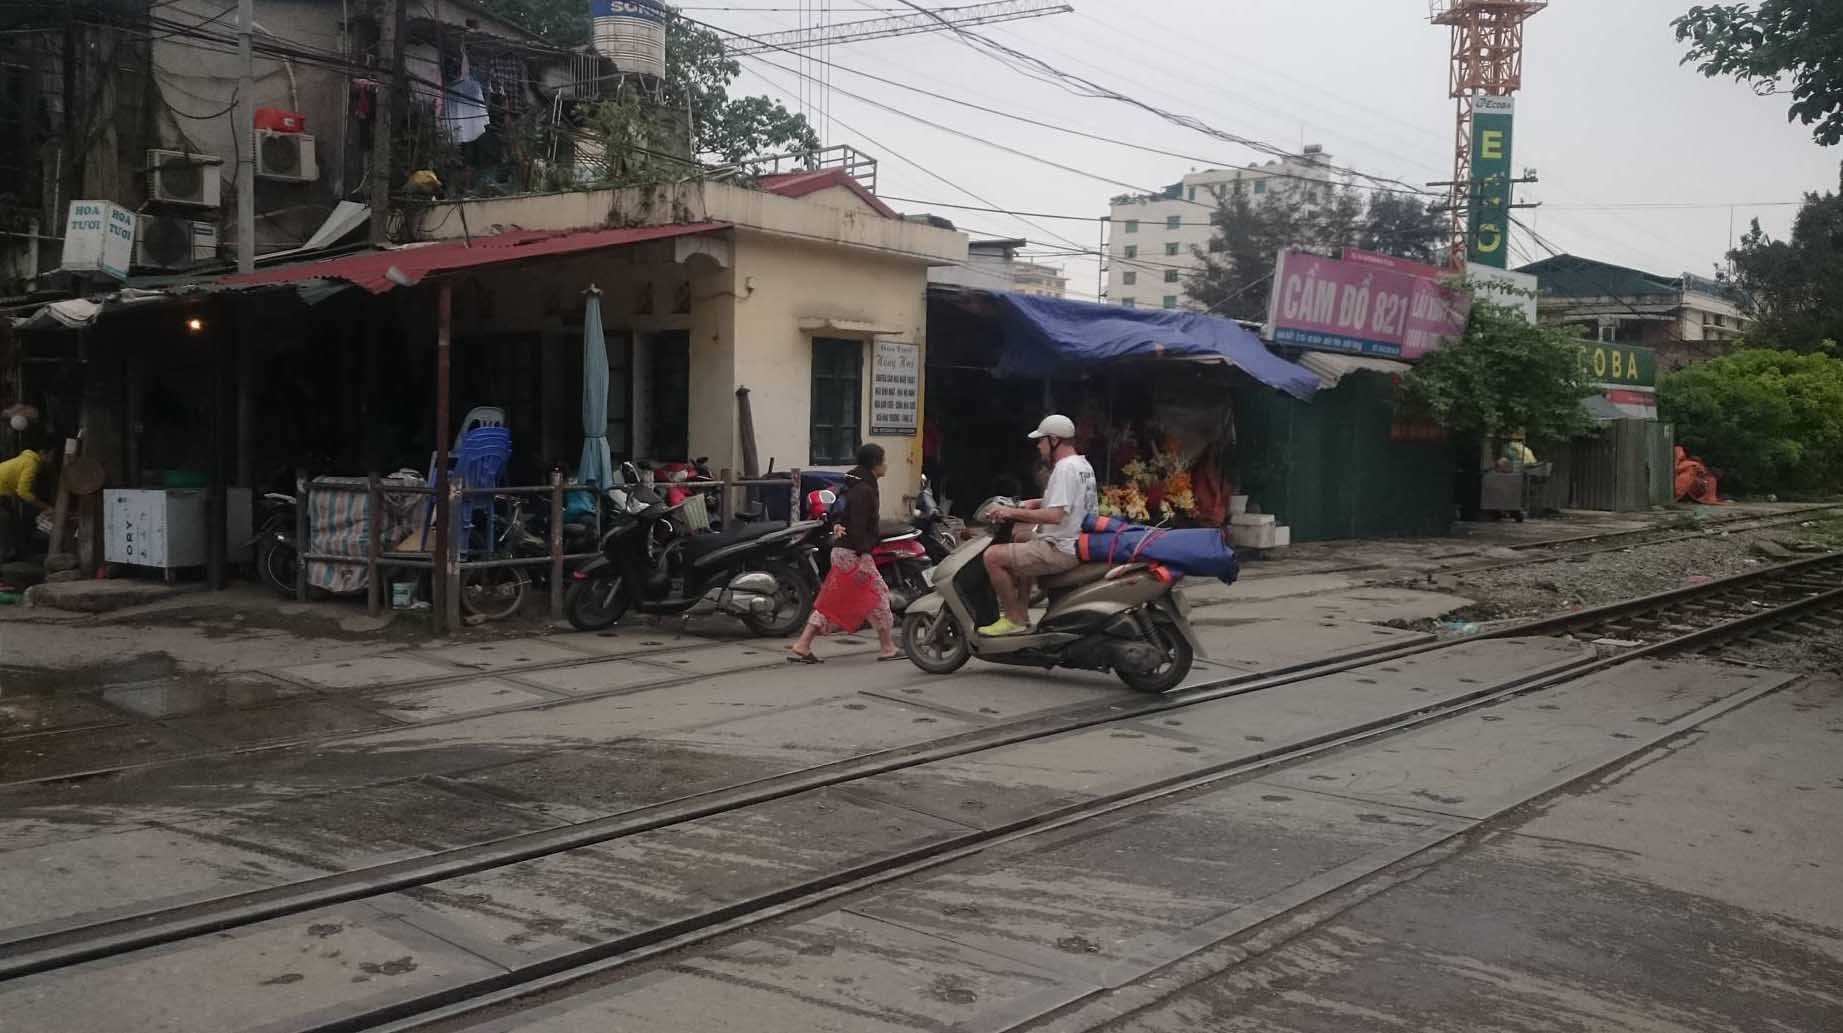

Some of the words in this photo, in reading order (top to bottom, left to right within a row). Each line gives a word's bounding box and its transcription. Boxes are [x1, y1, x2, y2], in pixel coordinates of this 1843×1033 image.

[75, 206, 99, 215] HOA
[112, 210, 130, 225] HOA
[1372, 291, 1408, 336] 821
